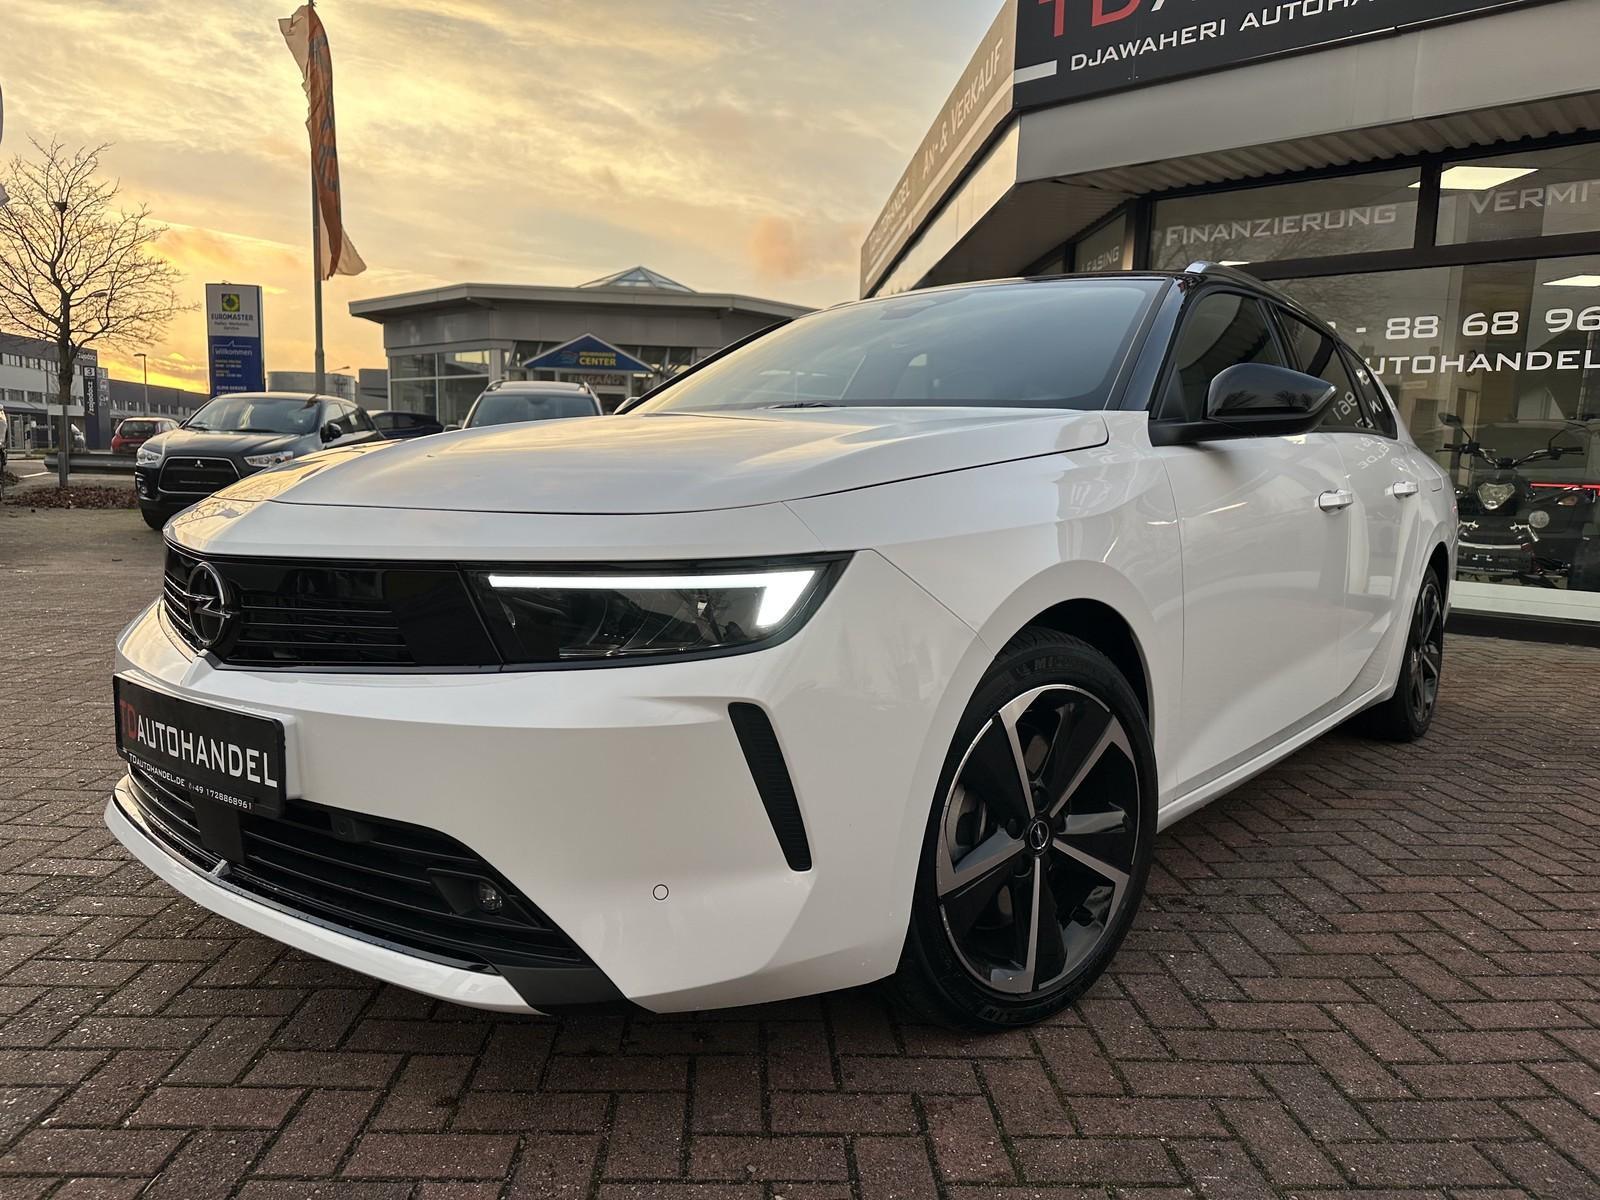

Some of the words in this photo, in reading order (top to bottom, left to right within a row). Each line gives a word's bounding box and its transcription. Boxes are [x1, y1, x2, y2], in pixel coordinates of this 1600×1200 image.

[1070, 18, 1226, 71] DJAWAHERI
[1239, 0, 1360, 32] AUTOH
[951, 37, 1003, 135] VERKAUF
[1165, 203, 1398, 247] FINANZIERUNG
[211, 313, 254, 321] EUROMASTER
[1385, 315, 1439, 340] 88
[1462, 310, 1519, 337] 68
[1545, 305, 1600, 333] 96
[579, 357, 617, 367] CENTER
[120, 699, 278, 788] TDAUTOHANDEL
[128, 752, 186, 787] TDAUTOHANDEL.DE
[205, 788, 253, 810] 1728868961
